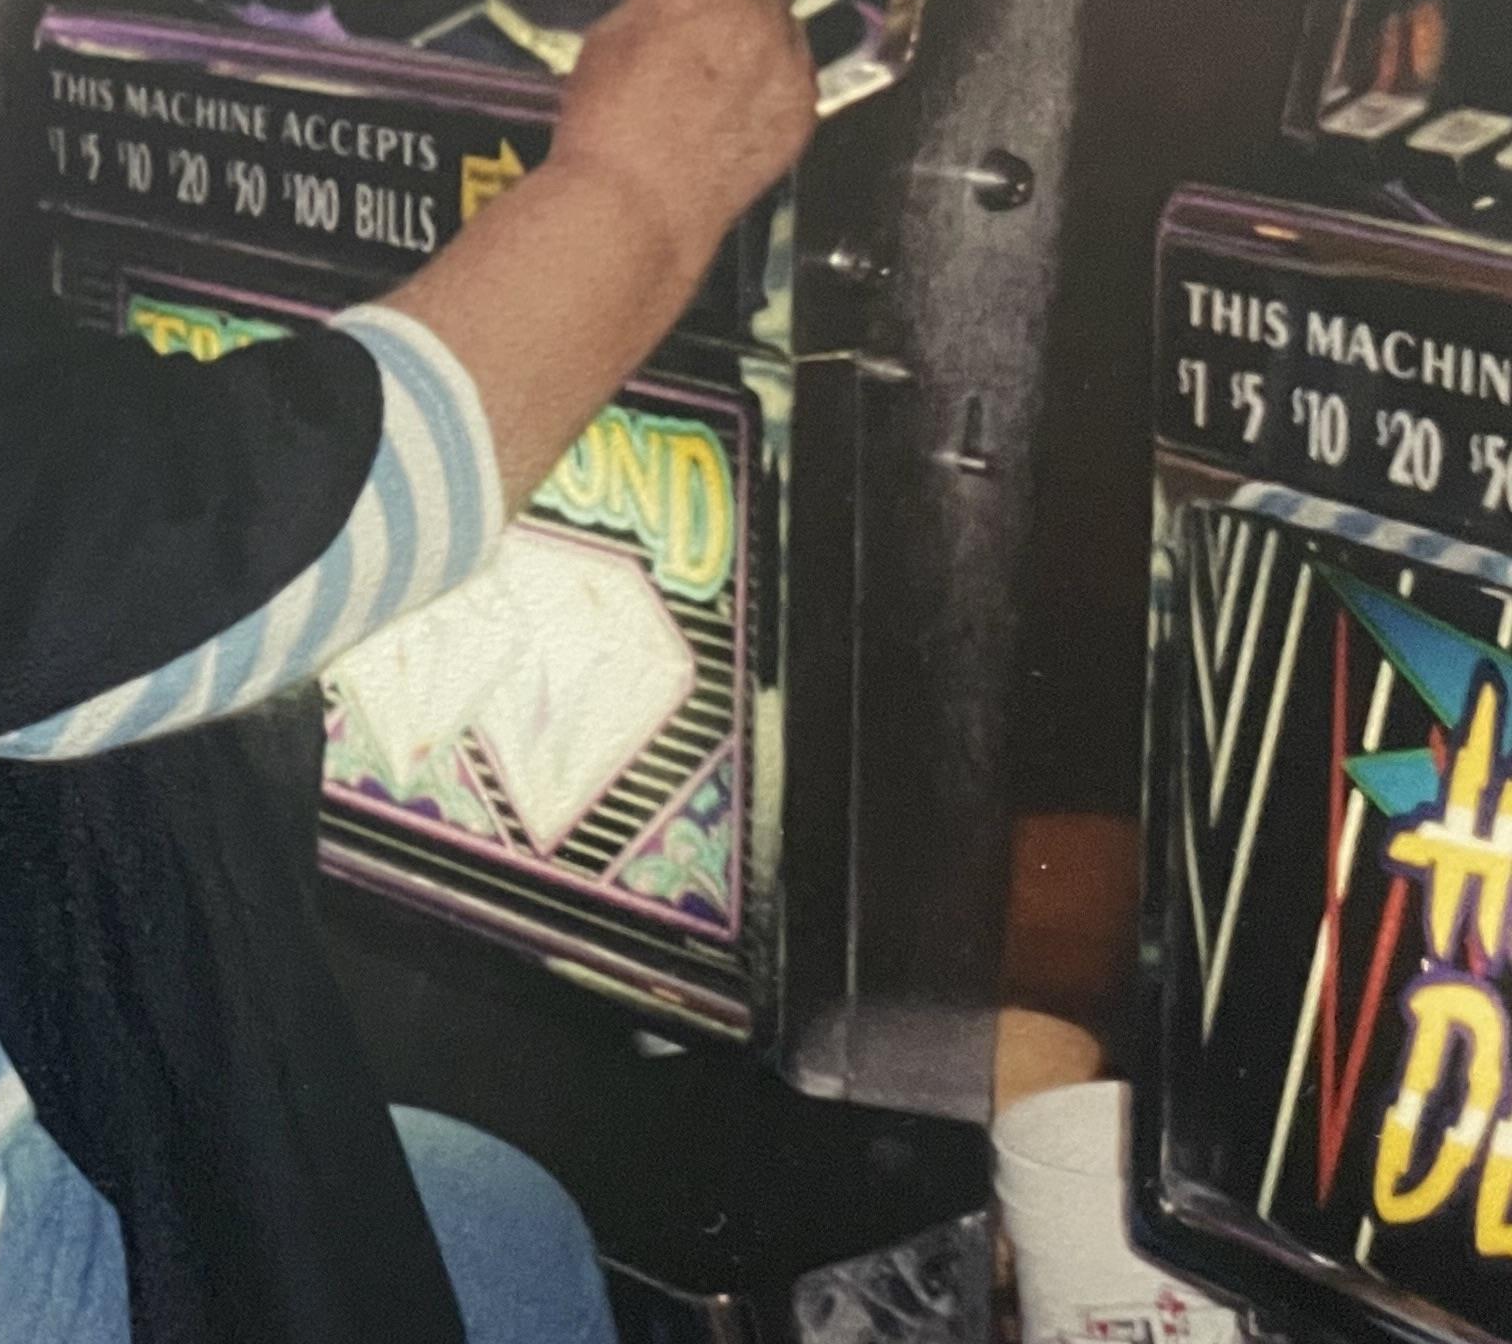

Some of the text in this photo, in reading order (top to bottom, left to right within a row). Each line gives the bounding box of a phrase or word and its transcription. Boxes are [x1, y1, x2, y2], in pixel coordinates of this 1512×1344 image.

[50, 69, 439, 172] THIS MACHINE ACCEPTS
[354, 182, 438, 253] BILLS
[1183, 280, 1291, 350] THIS
[1177, 356, 1208, 428] $1
[1231, 370, 1266, 443] $5
[1292, 386, 1349, 466] $10
[1375, 408, 1443, 492] $20
